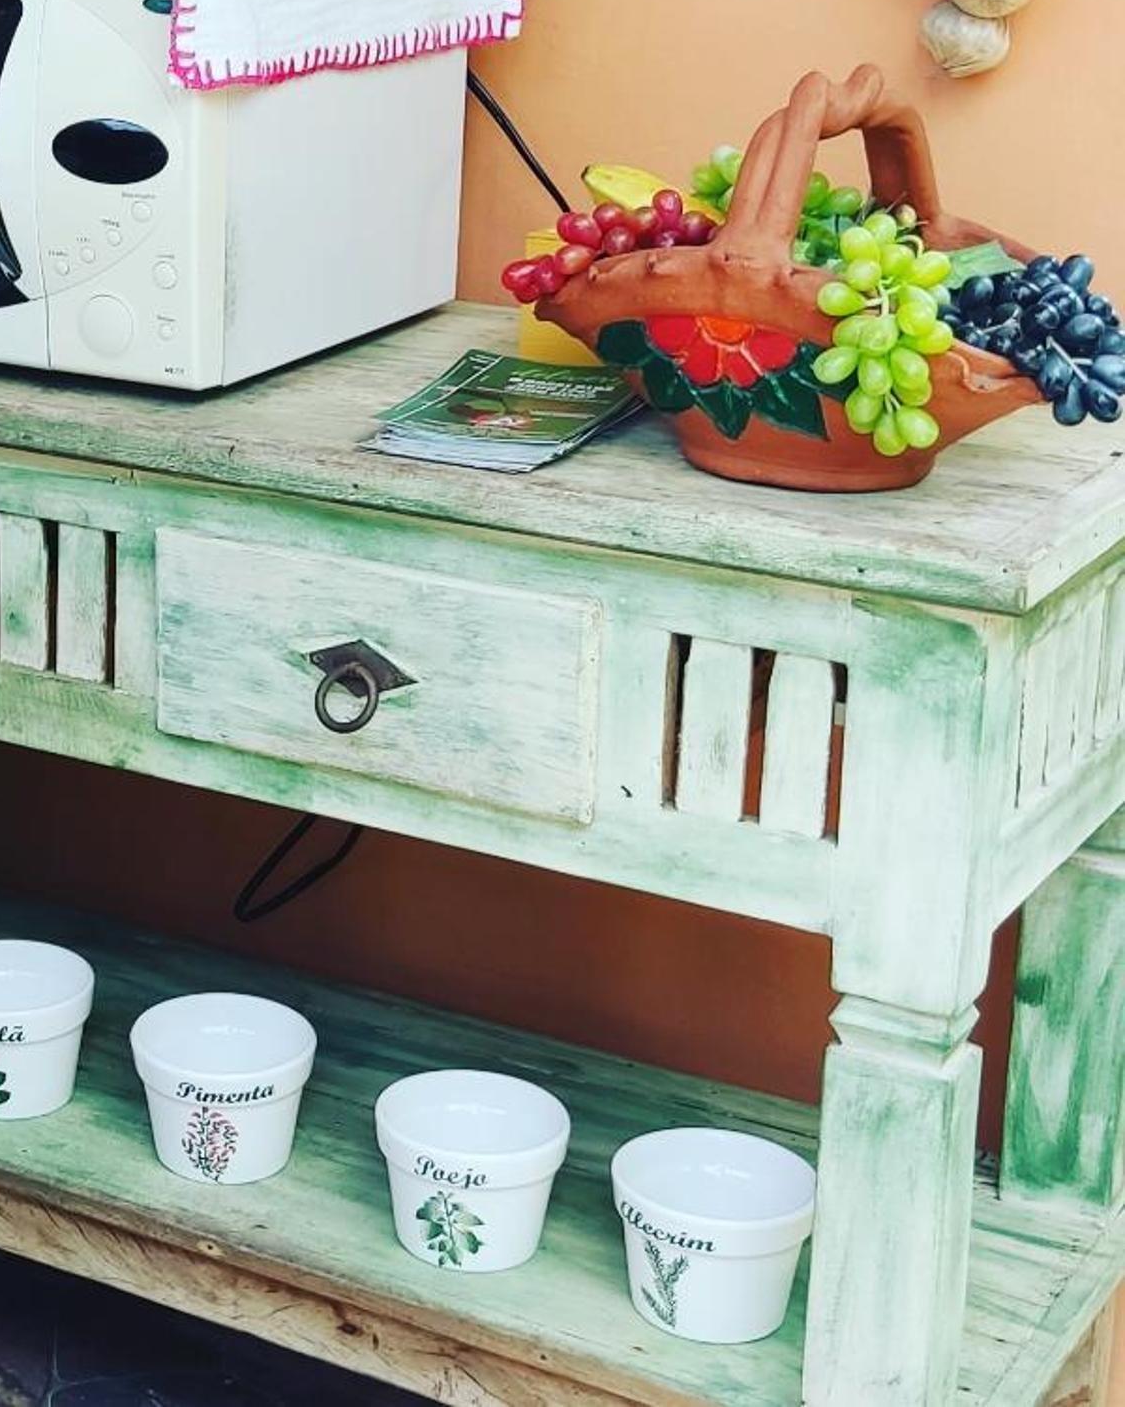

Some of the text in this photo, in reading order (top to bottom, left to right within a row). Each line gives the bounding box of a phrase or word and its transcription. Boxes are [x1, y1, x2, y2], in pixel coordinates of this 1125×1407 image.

[176, 1080, 275, 1107] Pimenta
[413, 1154, 489, 1190] Poejo
[619, 1198, 717, 1253] Alecrim
